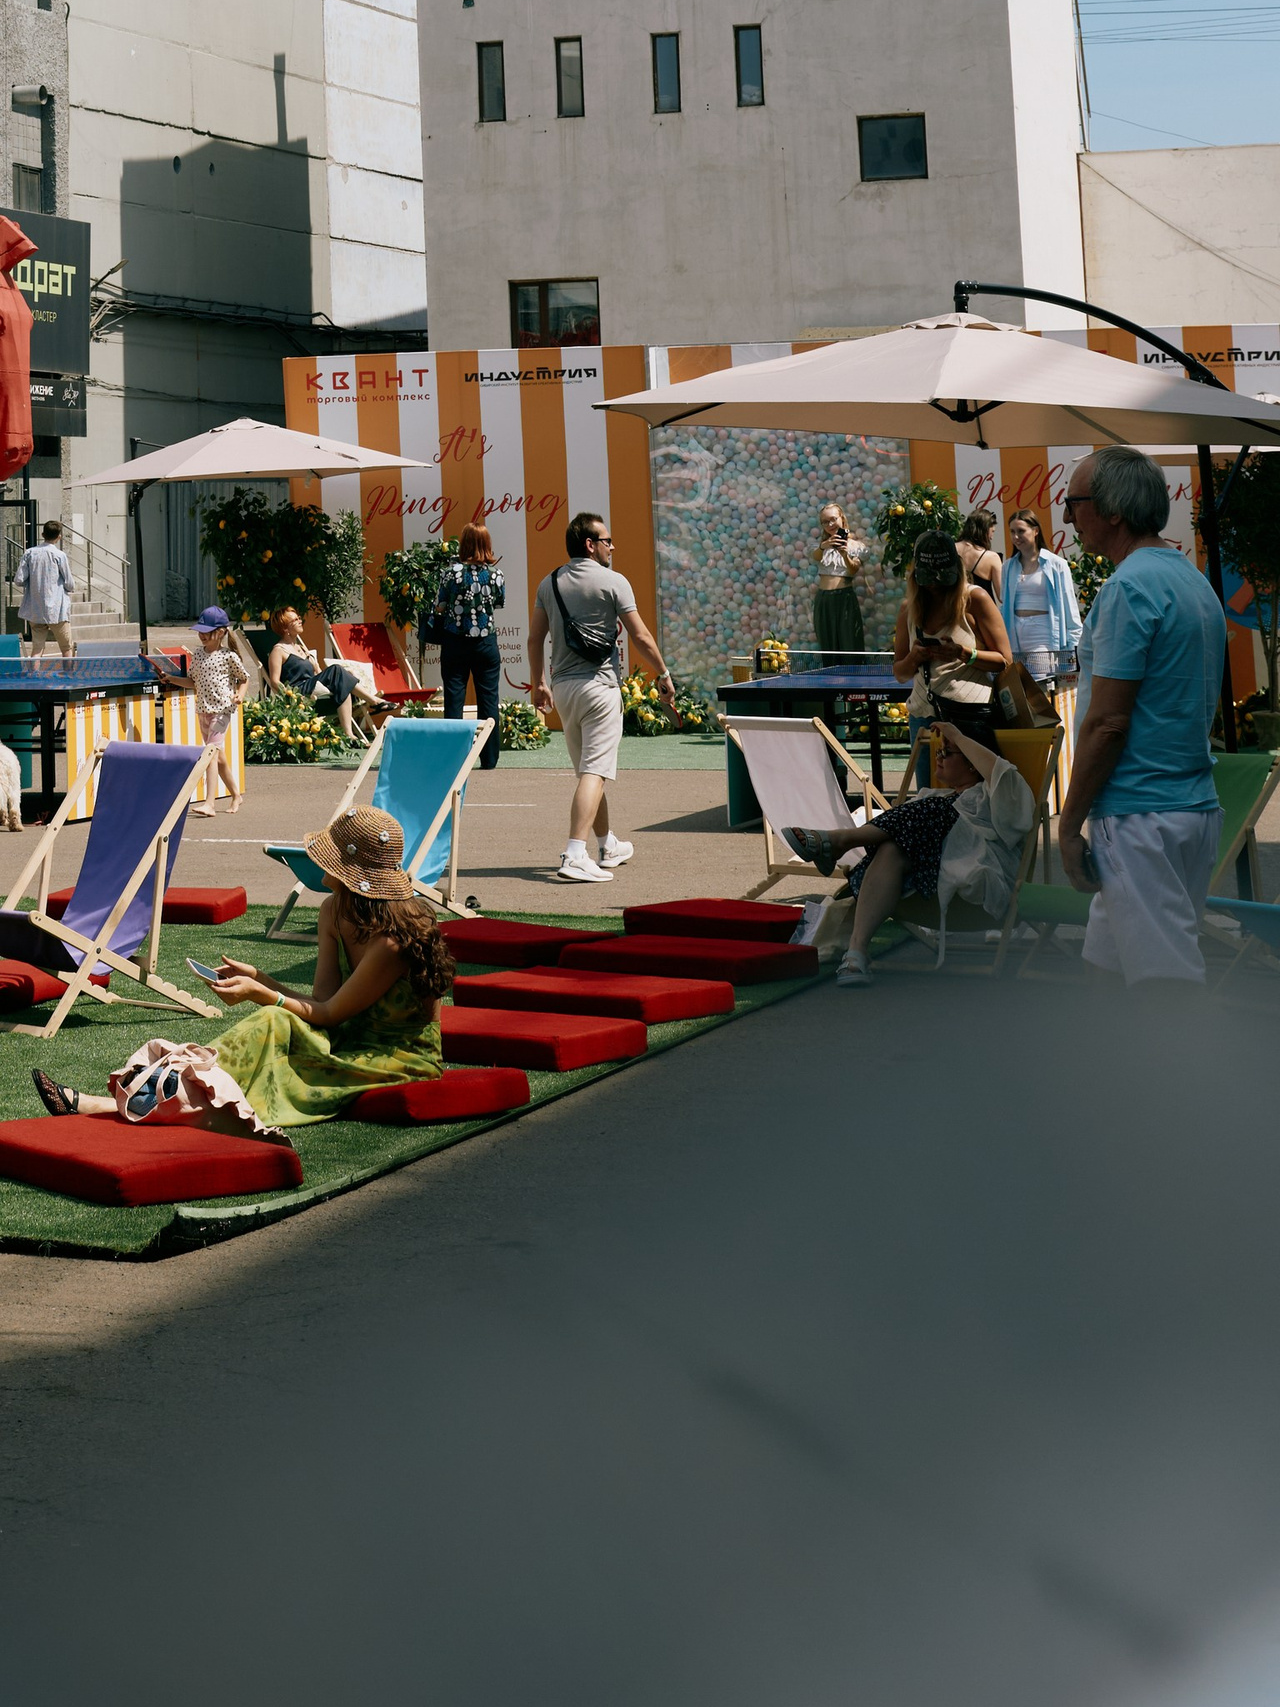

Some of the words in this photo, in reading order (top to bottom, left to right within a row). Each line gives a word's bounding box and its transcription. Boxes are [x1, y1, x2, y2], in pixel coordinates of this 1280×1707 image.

[306, 368, 429, 391] КВАНТ
[464, 367, 597, 383] ИНДУСТРИЯ
[306, 394, 367, 404] торговый
[372, 394, 430, 402] комплекс
[366, 485, 459, 534] Ping
[472, 492, 567, 532] pong
